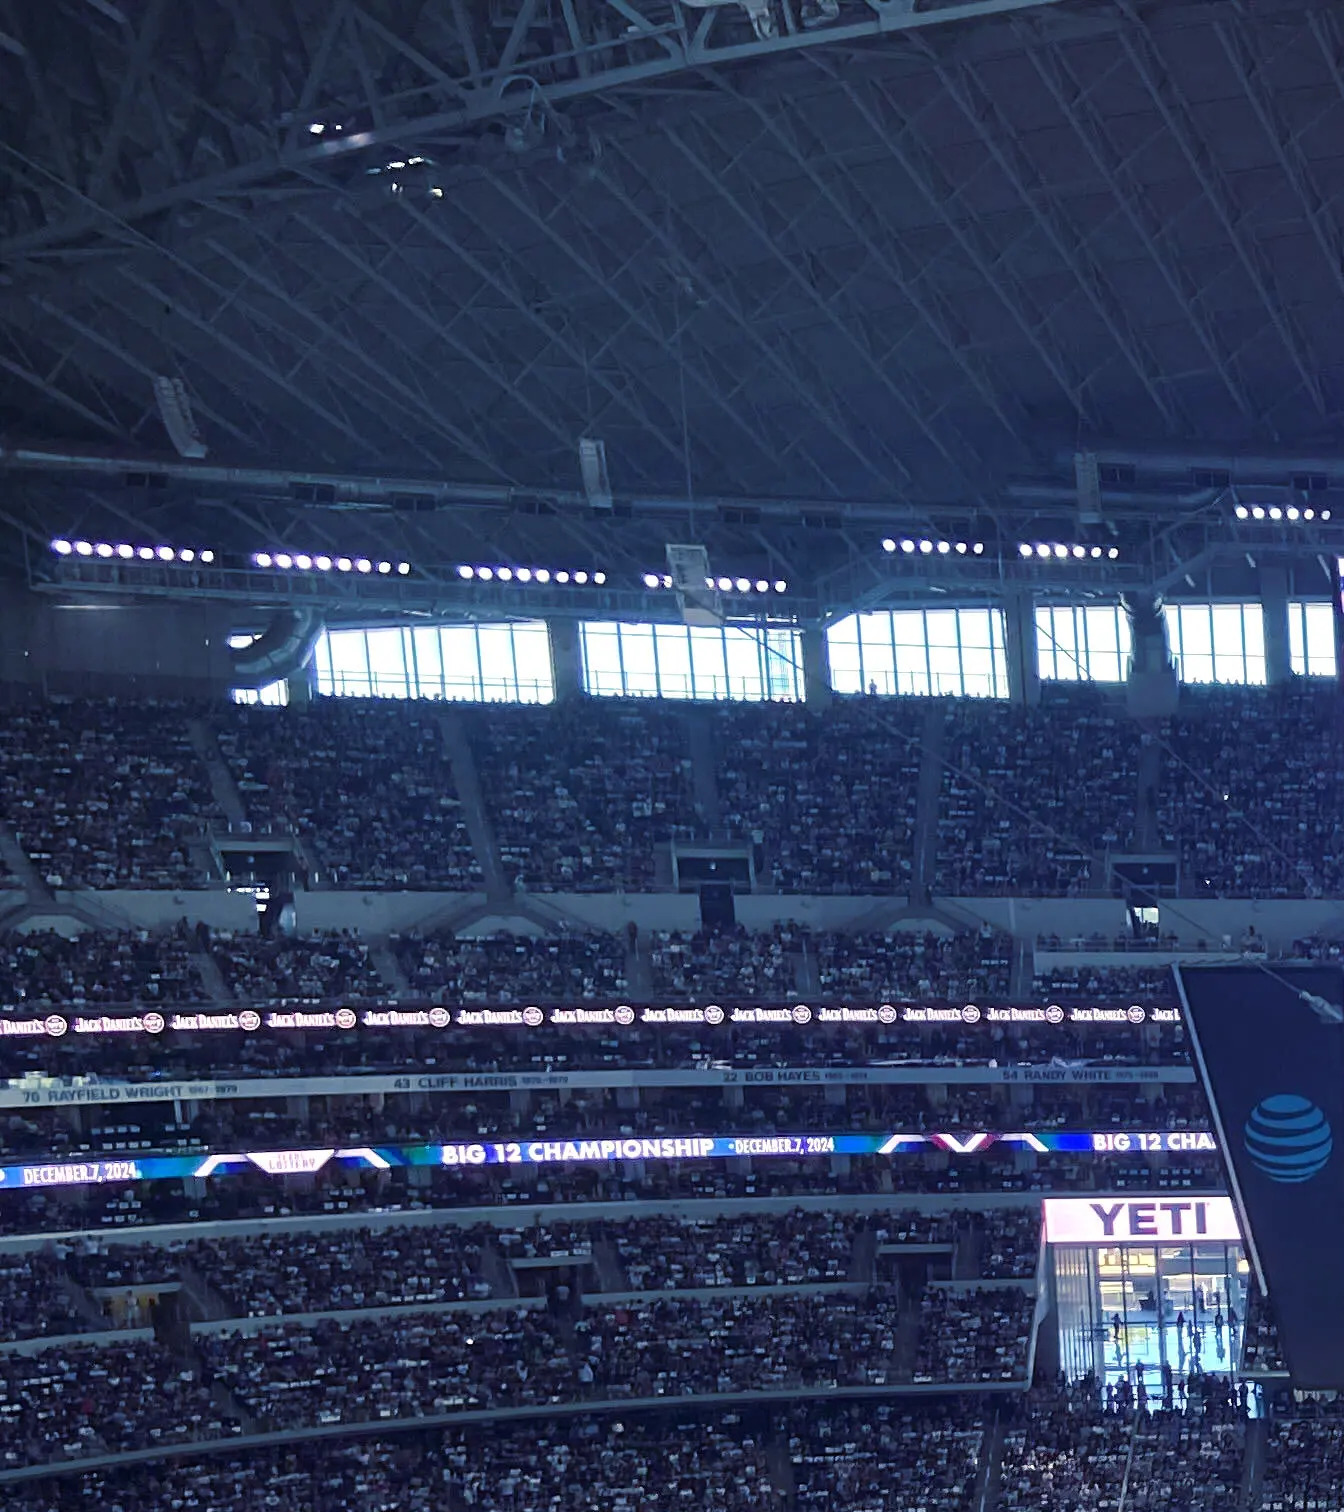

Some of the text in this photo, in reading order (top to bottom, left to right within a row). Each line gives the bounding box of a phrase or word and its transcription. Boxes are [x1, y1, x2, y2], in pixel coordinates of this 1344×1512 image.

[418, 1077, 458, 1089] CLIFF
[464, 1075, 517, 1088] HARRIS
[745, 1071, 774, 1082] BOB
[778, 1070, 821, 1082] HAYES
[1003, 1070, 1018, 1081] 54
[1024, 1070, 1066, 1081] RANDY
[1072, 1070, 1112, 1081] WHITE
[23, 1092, 40, 1103] 70
[49, 1087, 120, 1102] RAYFIELD
[125, 1085, 183, 1100] WRIGHT
[441, 1144, 487, 1166] BIG
[496, 1143, 522, 1164] 12
[528, 1138, 715, 1163] CHAMPIONSHIP
[735, 1137, 793, 1154] DECEMBER
[807, 1136, 835, 1153] 2024
[1093, 1133, 1130, 1151] BIG
[1138, 1133, 1162, 1150] 12
[23, 1165, 87, 1185] DECEMBER
[106, 1161, 138, 1180] 2024
[1090, 1202, 1207, 1236] YETI
